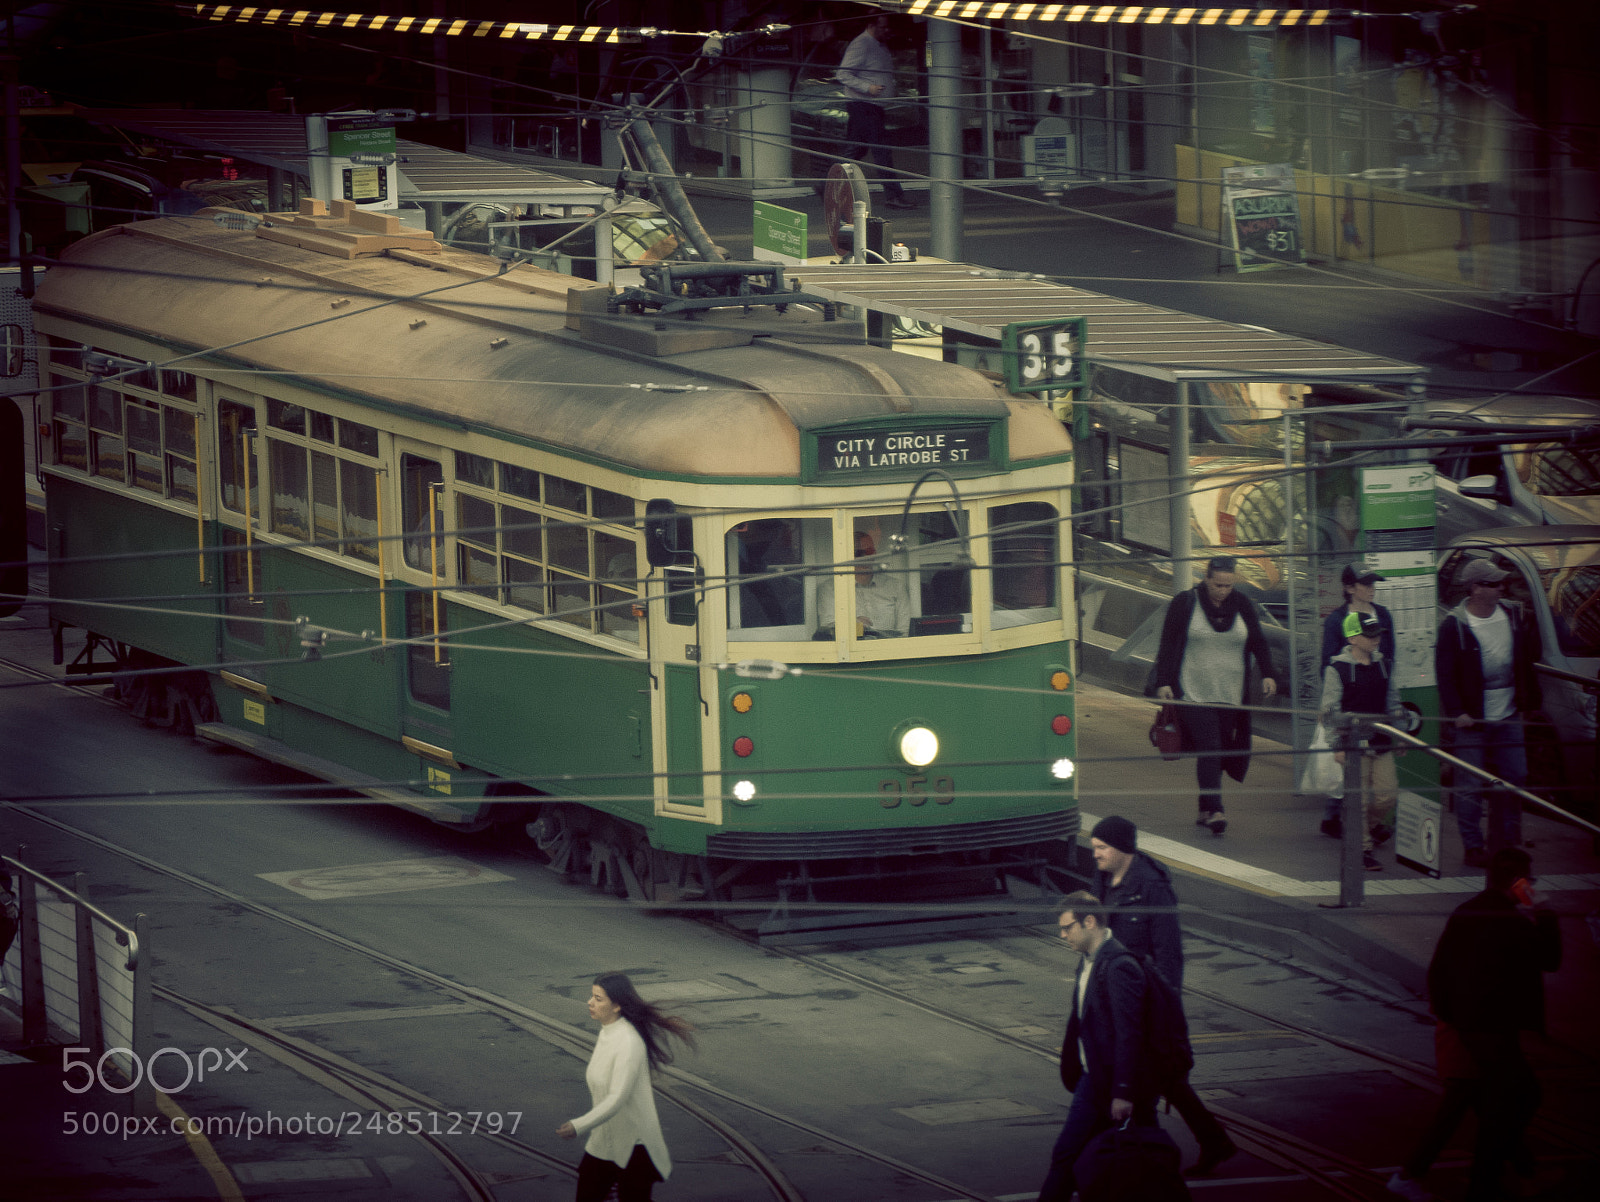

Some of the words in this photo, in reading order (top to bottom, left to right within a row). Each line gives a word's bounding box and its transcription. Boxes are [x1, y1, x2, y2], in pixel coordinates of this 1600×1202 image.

[343, 132, 370, 143] Spencer
[371, 131, 392, 139] Street
[1023, 332, 1073, 379] 35
[836, 438, 876, 453] CITY
[885, 434, 946, 450] CIRCLE
[834, 455, 860, 469] VIA
[869, 450, 941, 467] LATROBE
[950, 448, 970, 462] ST
[878, 775, 955, 810] 959
